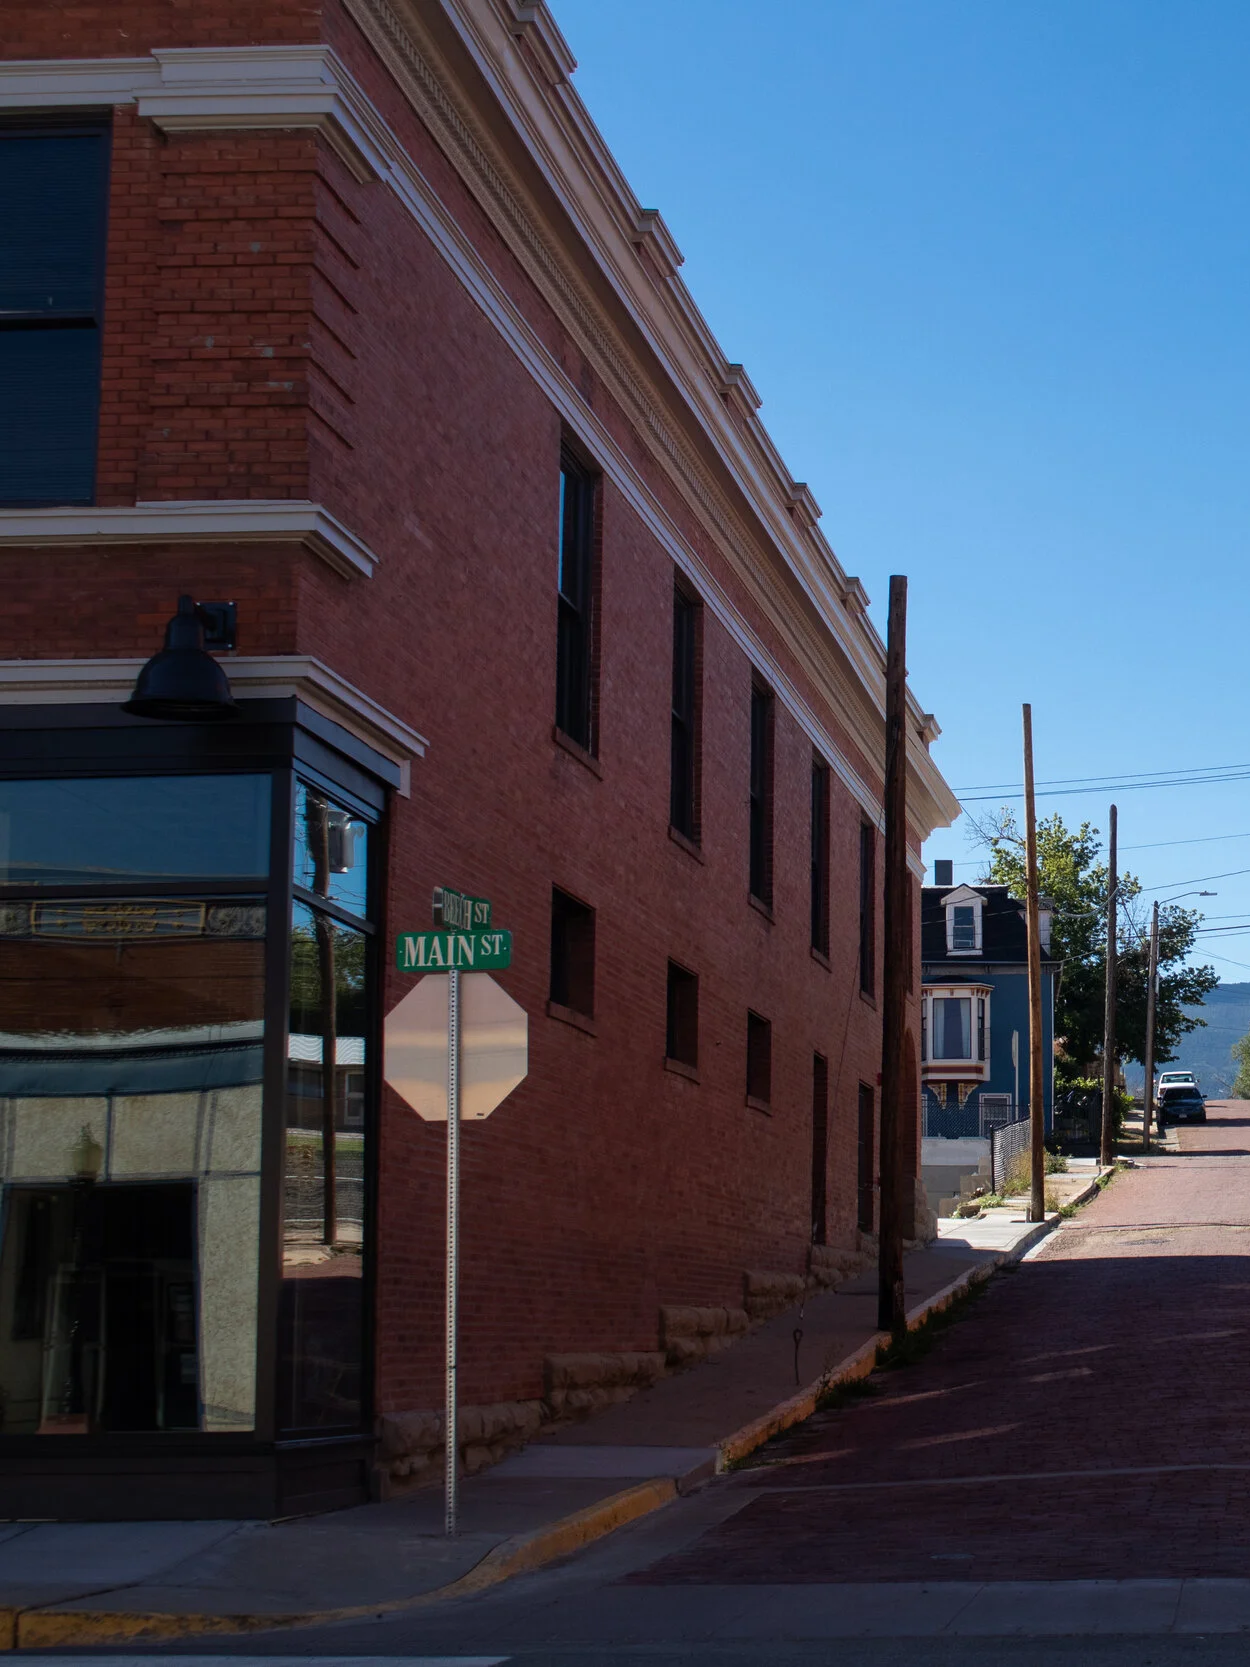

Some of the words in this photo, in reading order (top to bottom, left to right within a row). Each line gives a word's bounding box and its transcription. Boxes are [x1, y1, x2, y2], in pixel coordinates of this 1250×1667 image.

[474, 901, 490, 924] ST
[404, 934, 477, 967] MAIN
[481, 934, 504, 956] ST
